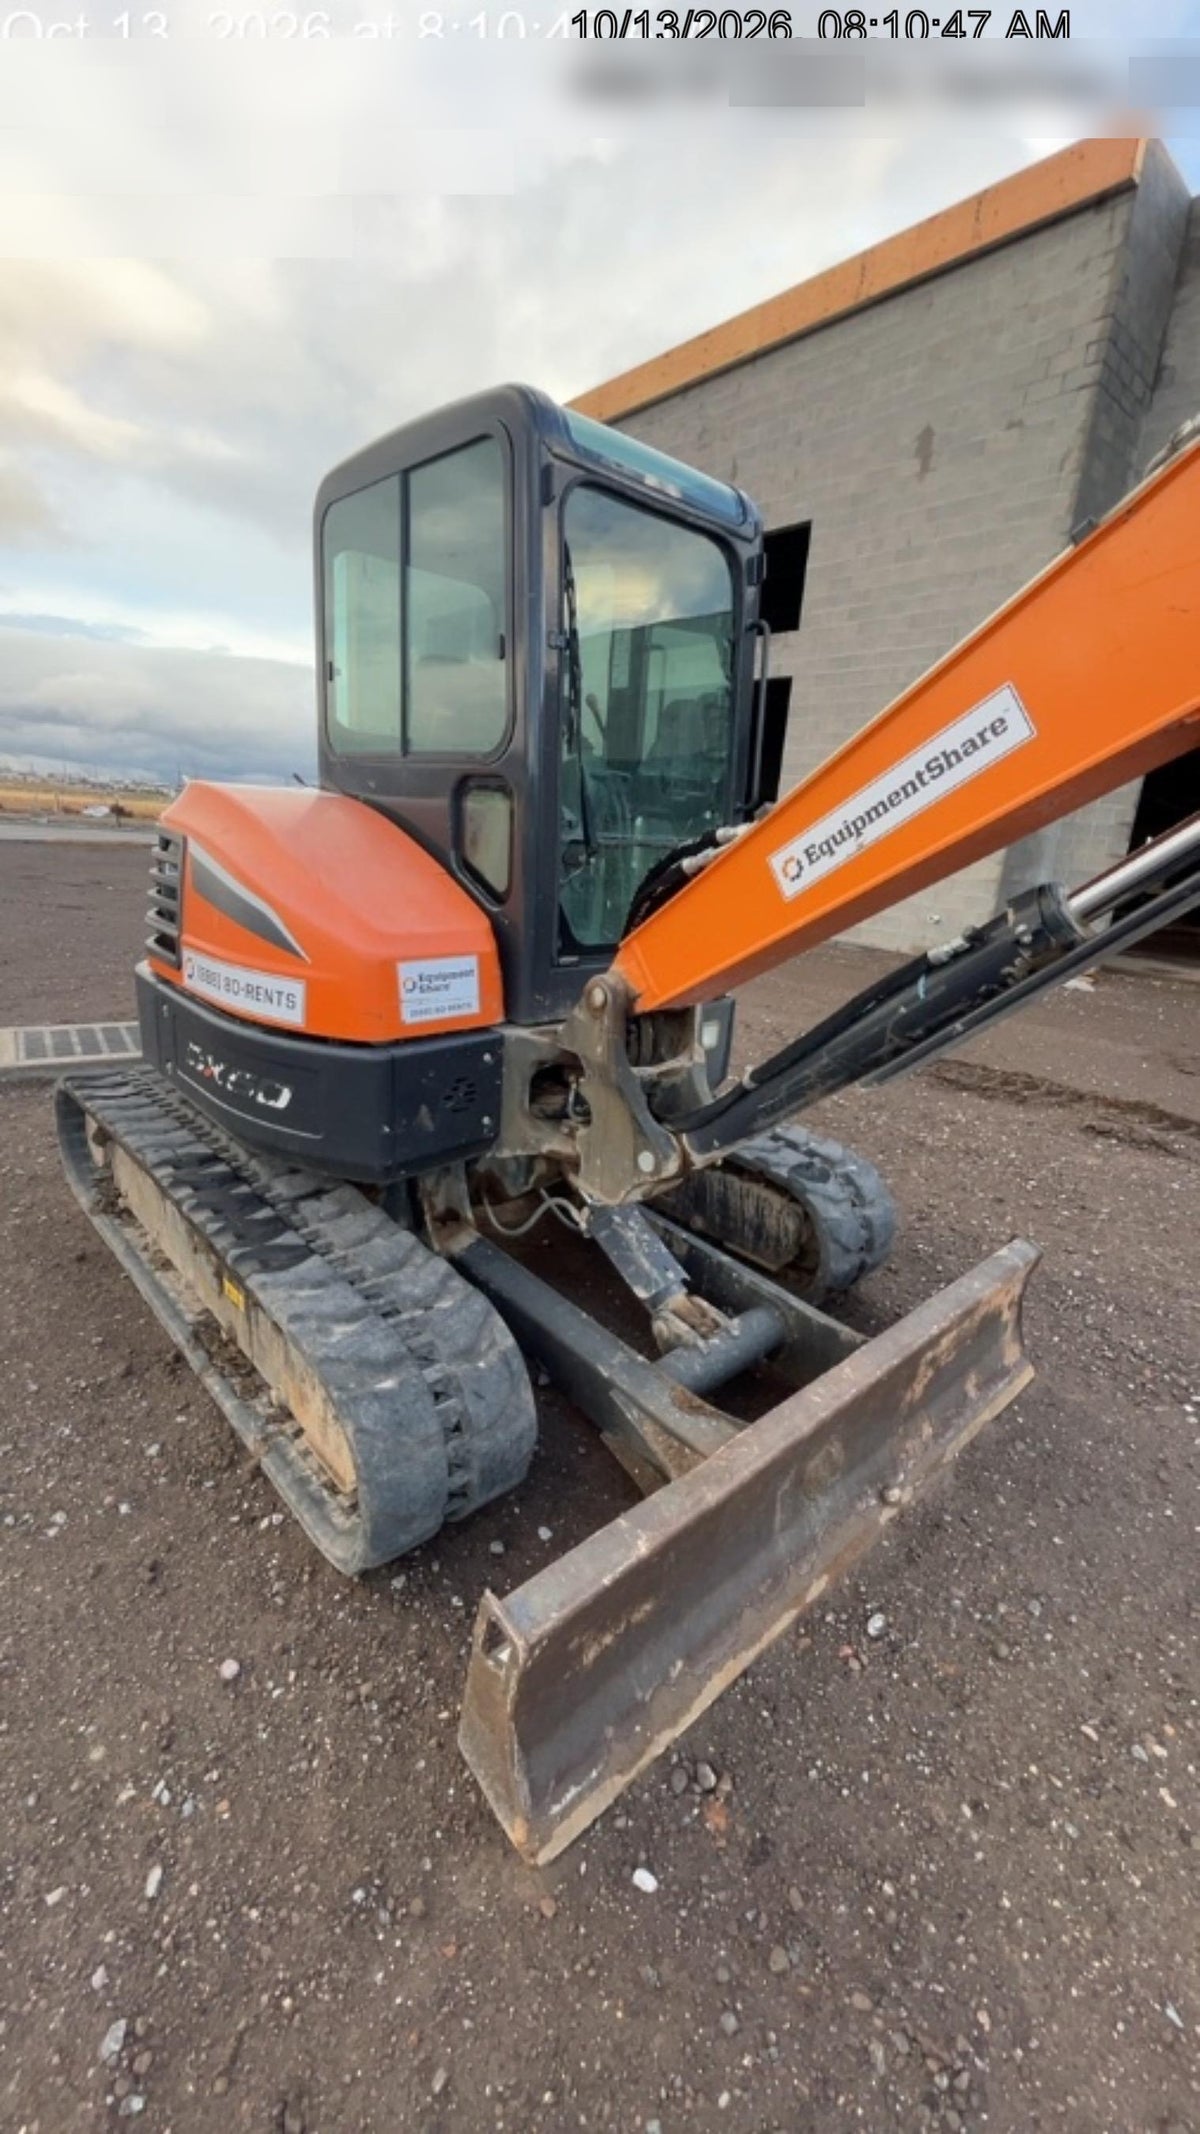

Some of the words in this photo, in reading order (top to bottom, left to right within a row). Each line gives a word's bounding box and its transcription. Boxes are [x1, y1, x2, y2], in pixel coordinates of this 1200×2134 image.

[802, 714, 1010, 867] EquipmentShare
[418, 969, 475, 984] Equipment
[419, 981, 450, 994] Share
[222, 976, 297, 1010] 80-RENTS
